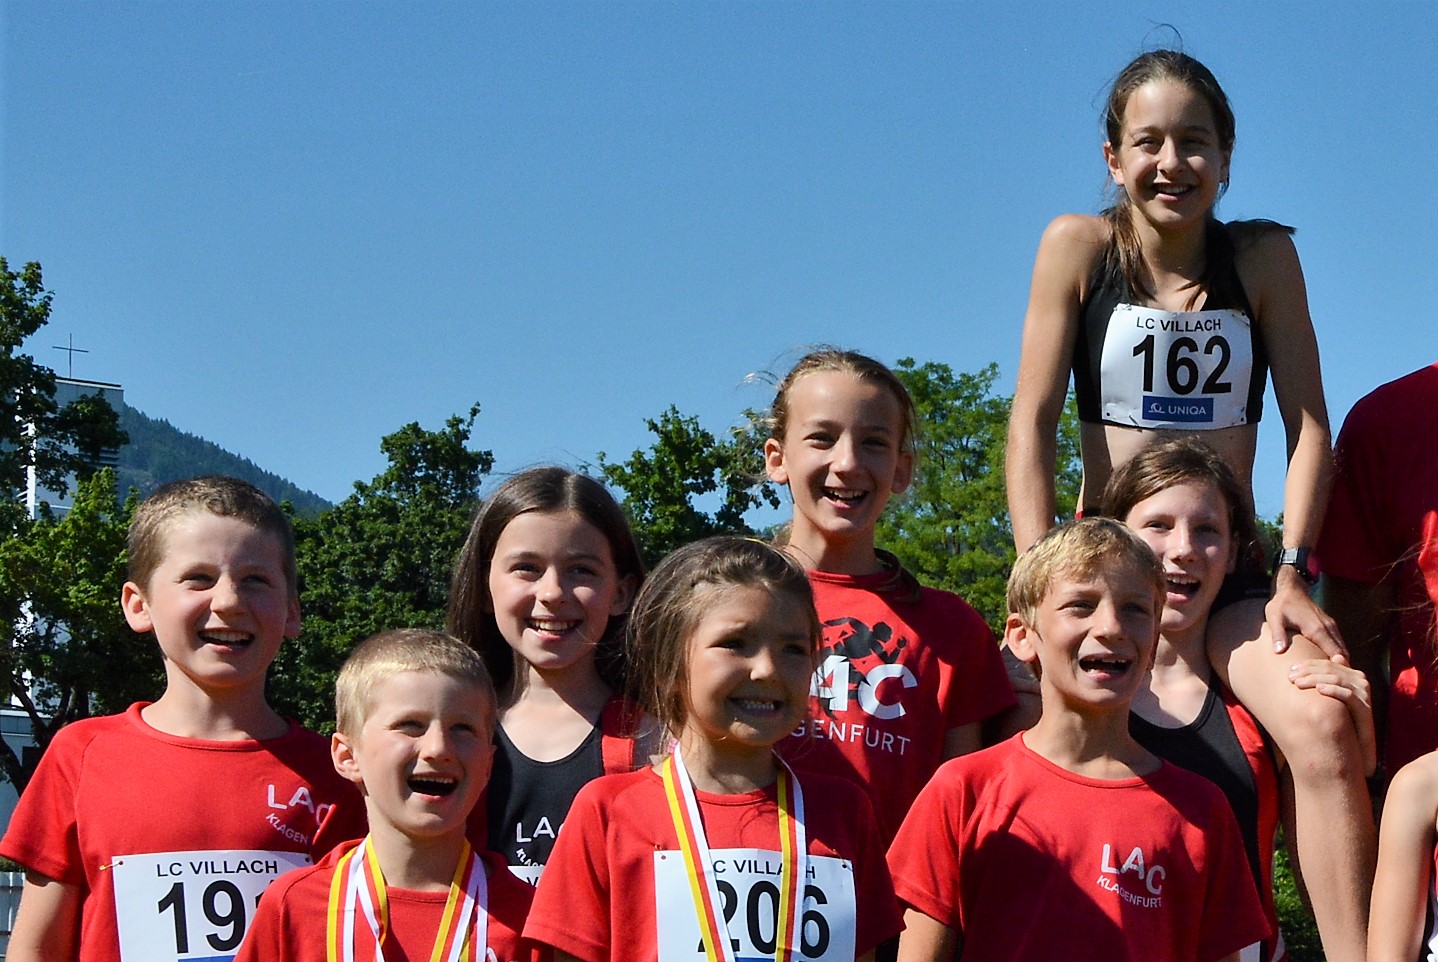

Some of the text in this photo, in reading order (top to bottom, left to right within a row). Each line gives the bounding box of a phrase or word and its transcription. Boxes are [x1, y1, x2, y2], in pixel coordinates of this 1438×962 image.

[1136, 316, 1221, 332] LC VILLACH
[1132, 334, 1232, 396] 162
[1168, 405, 1207, 415] UNIQA
[808, 655, 918, 720] AC
[790, 719, 911, 756] GENFURT
[266, 813, 309, 845] KLAGEN
[516, 816, 565, 843] LA
[156, 860, 278, 877] LC VILLACH
[713, 860, 726, 874] C
[1101, 843, 1166, 895] LAC
[157, 879, 276, 955] 19
